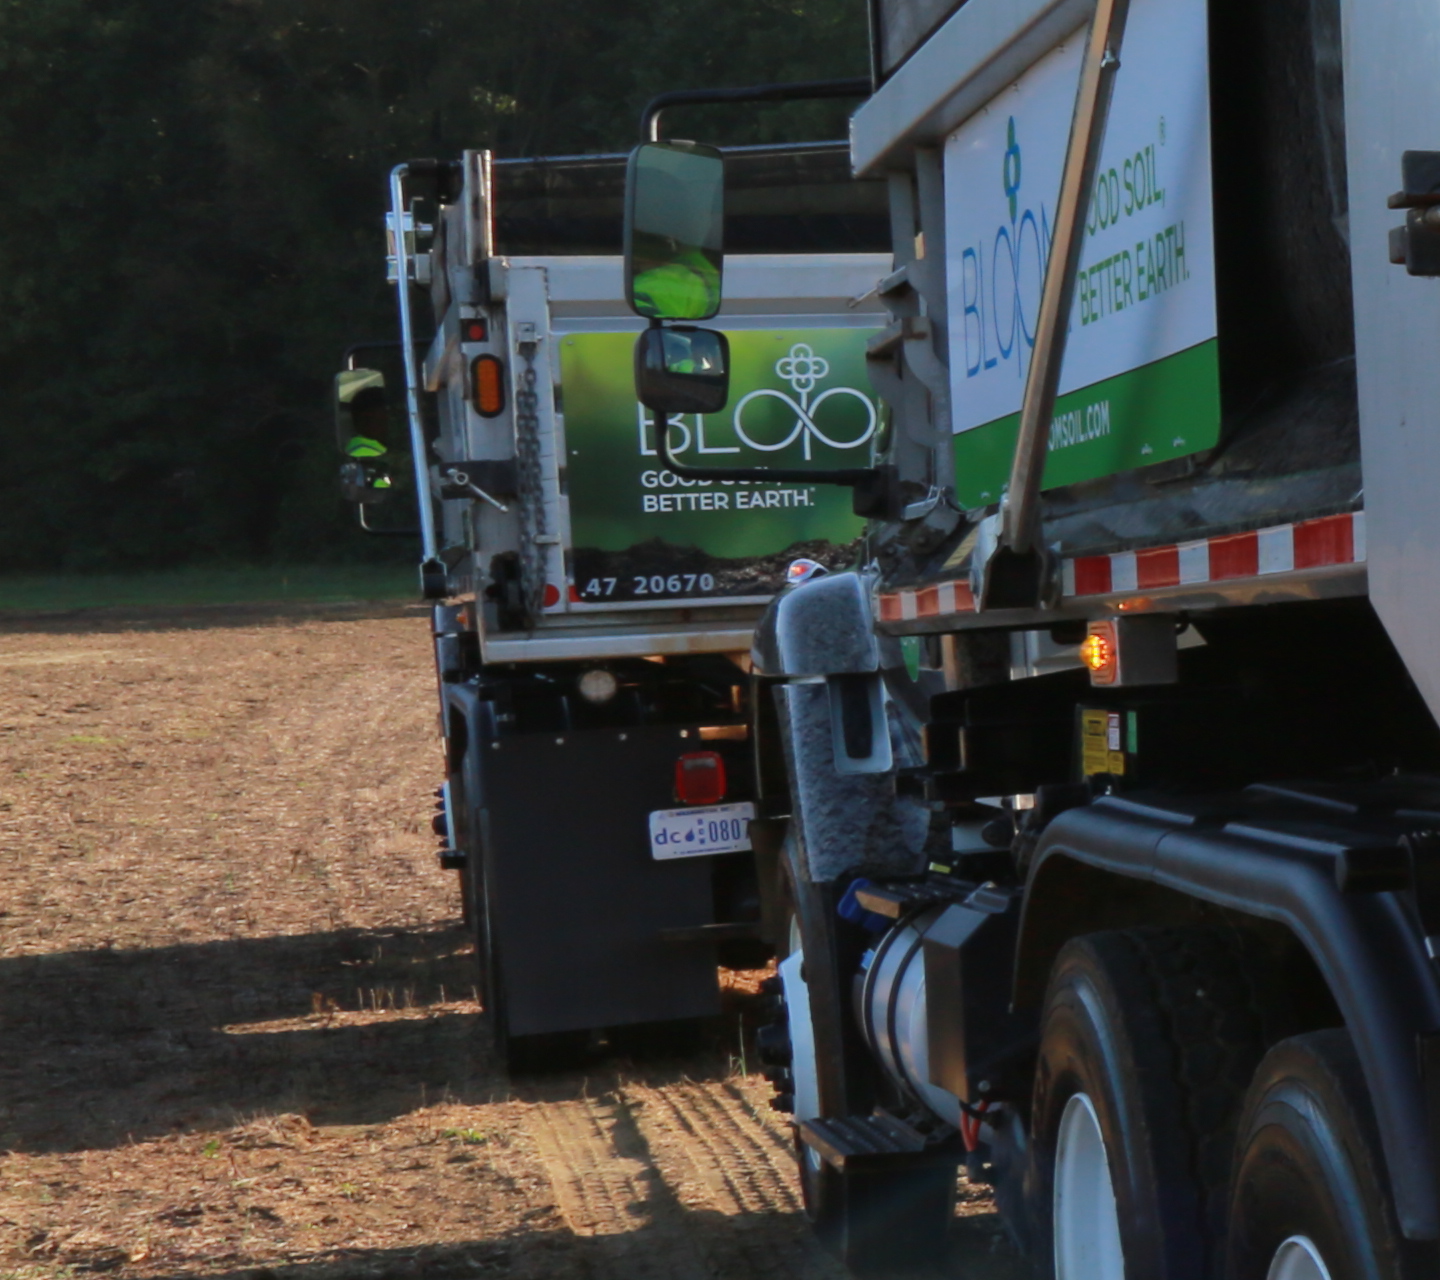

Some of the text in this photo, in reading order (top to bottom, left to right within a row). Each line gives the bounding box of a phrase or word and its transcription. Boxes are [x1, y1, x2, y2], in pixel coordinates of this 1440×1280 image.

[1123, 143, 1166, 217] SOIL,
[962, 201, 1060, 378] BLOO
[1078, 220, 1190, 327] BETTER EARTH.
[642, 492, 729, 513] BETTER
[585, 572, 715, 596] 47 20670
